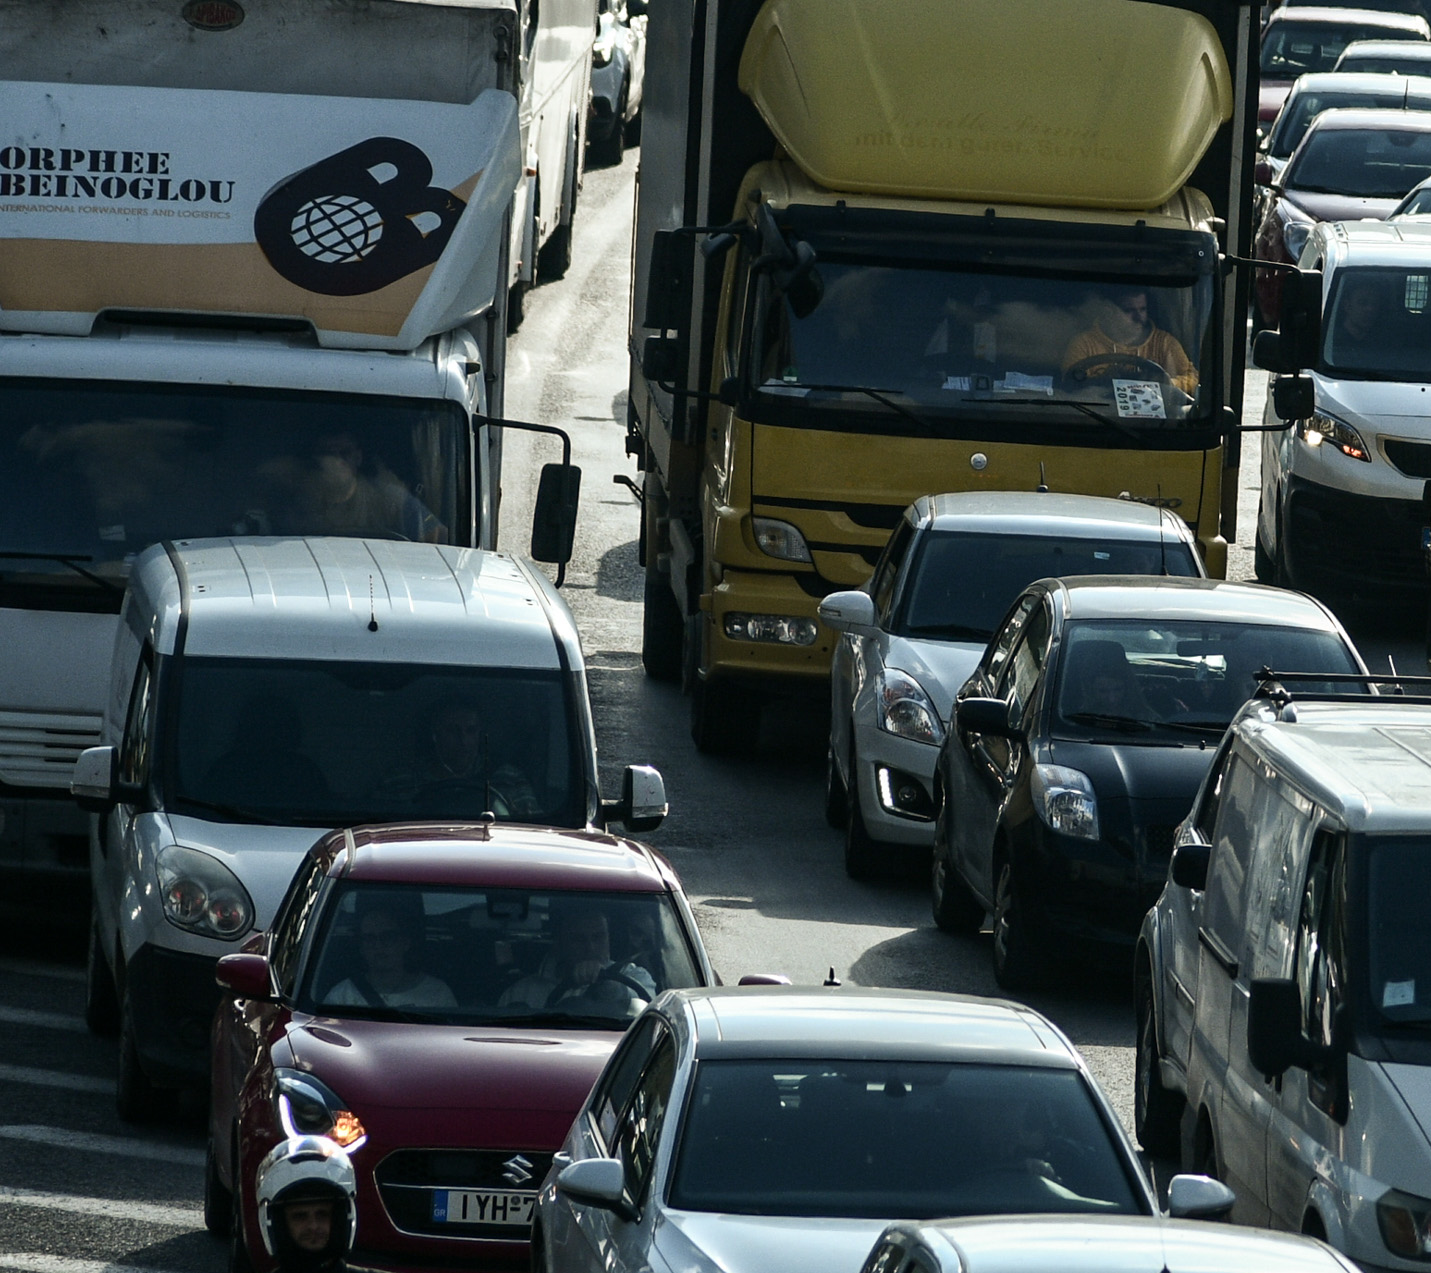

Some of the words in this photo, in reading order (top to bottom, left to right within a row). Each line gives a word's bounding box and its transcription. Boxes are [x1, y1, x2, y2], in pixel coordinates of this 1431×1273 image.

[0, 146, 170, 175] ORPHEE
[78, 205, 149, 217] FORWARDERS
[152, 208, 174, 218] AND
[177, 209, 231, 220] LOGISTICS
[434, 1208, 447, 1217] GR
